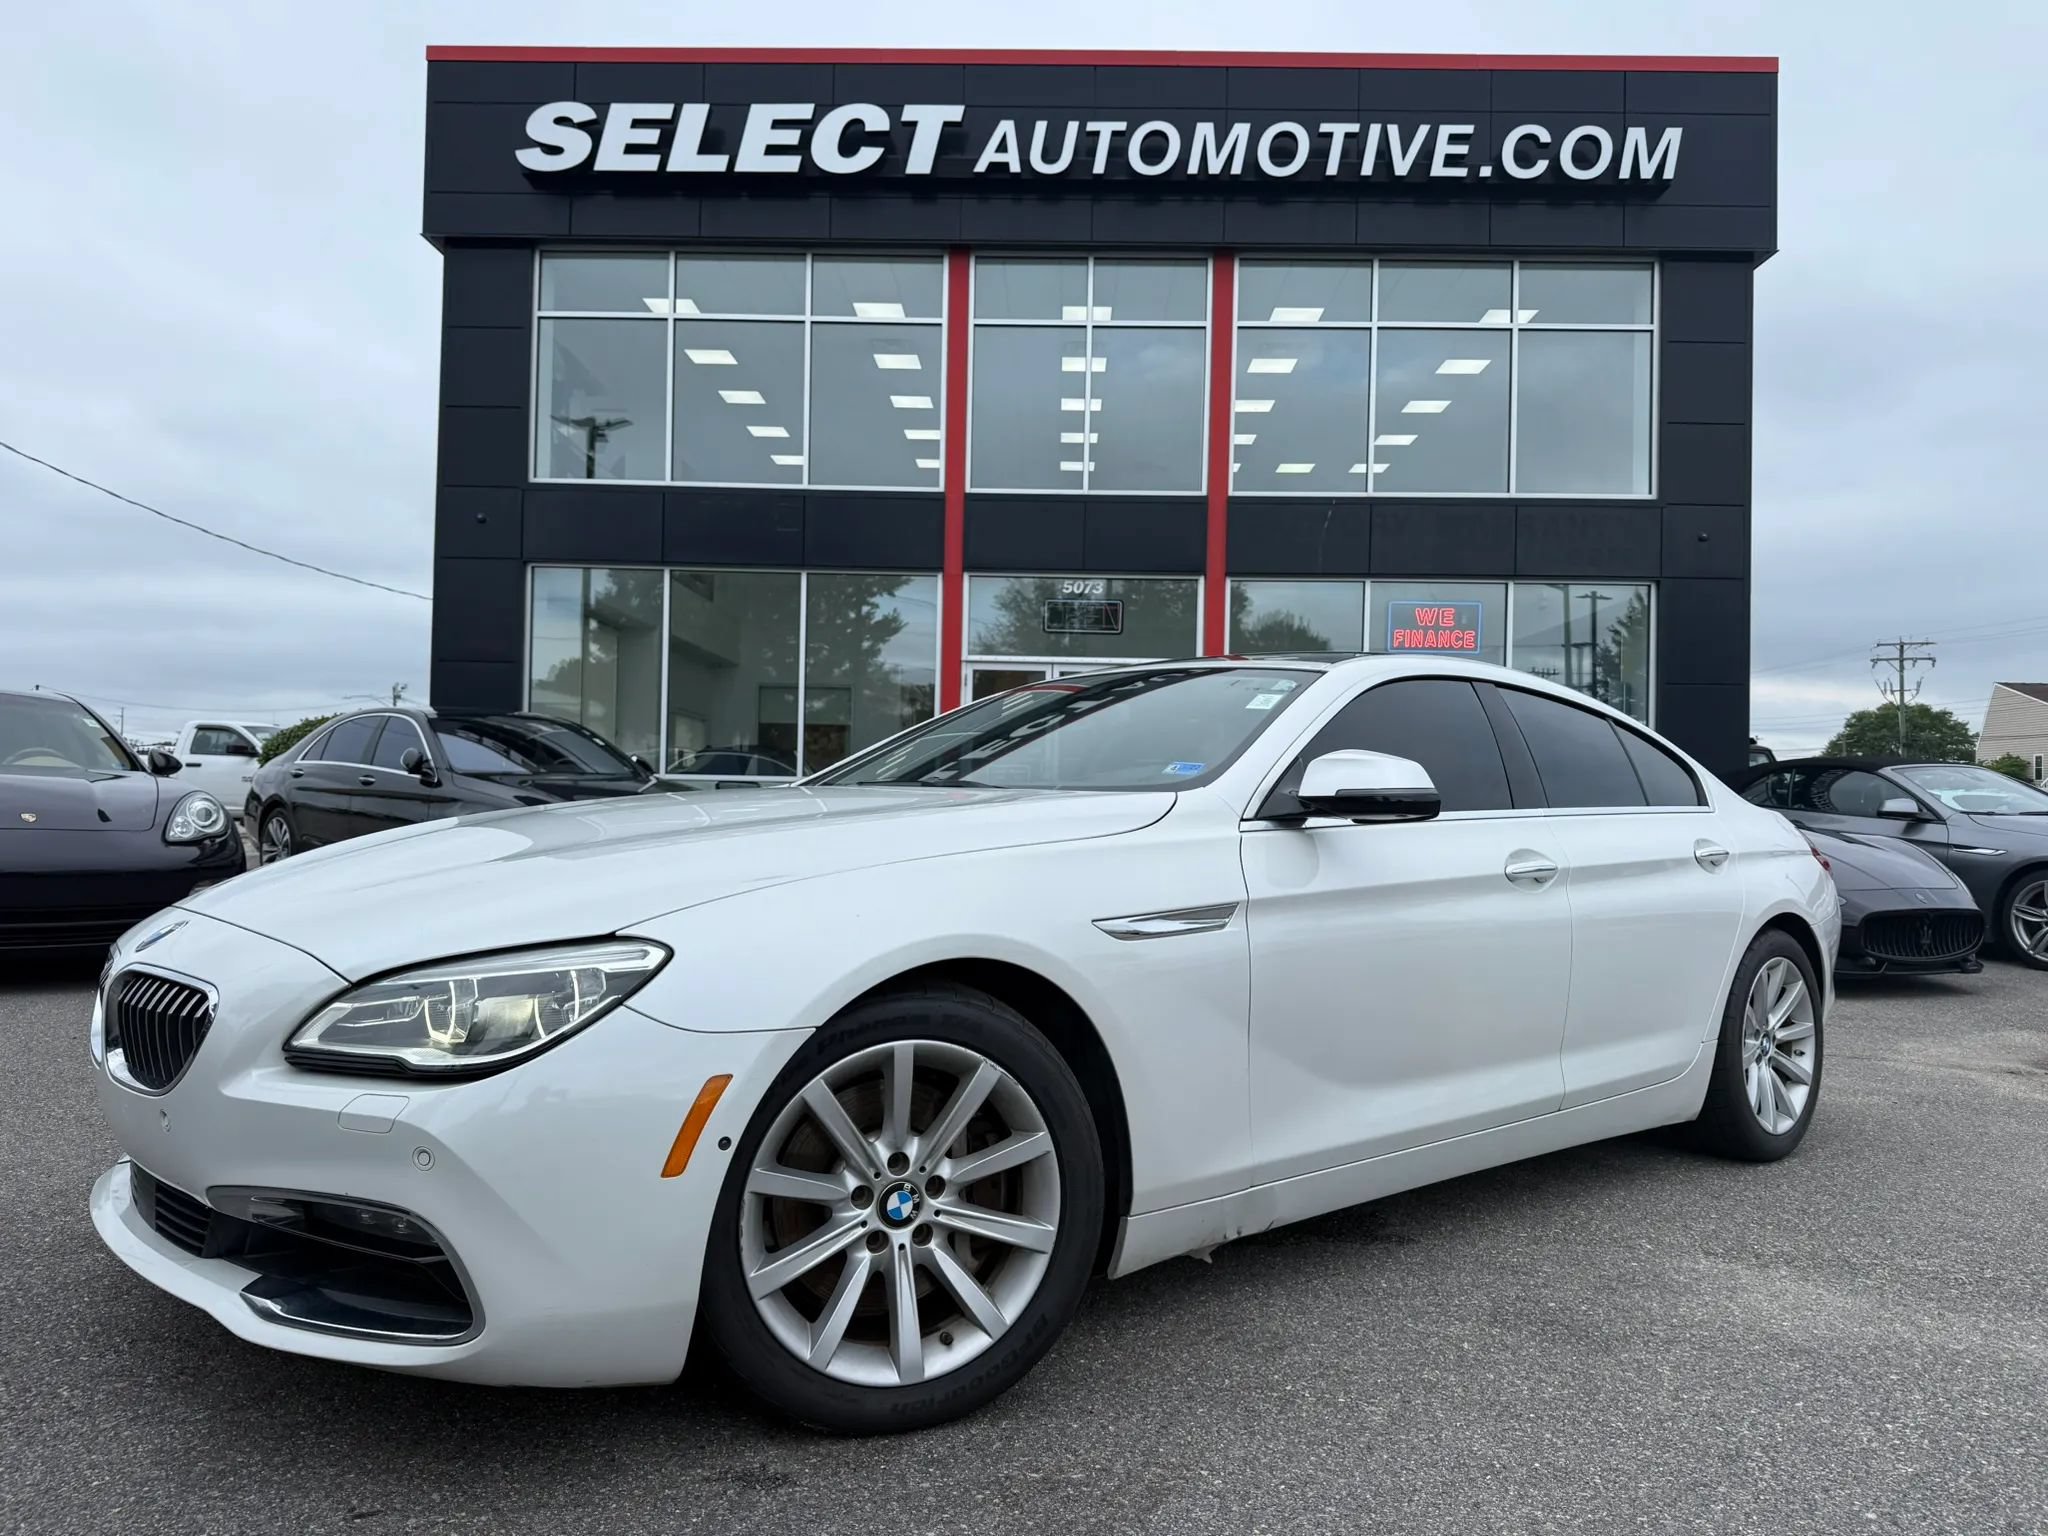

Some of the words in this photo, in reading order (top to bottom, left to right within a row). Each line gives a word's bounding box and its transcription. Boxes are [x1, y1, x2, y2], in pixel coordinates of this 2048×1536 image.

[515, 101, 965, 175] SELECT
[973, 119, 1683, 180] AUTOMOTIVE.COM
[1062, 581, 1104, 594] 5073
[1415, 607, 1455, 626] WE
[1393, 629, 1476, 648] FINANCE
